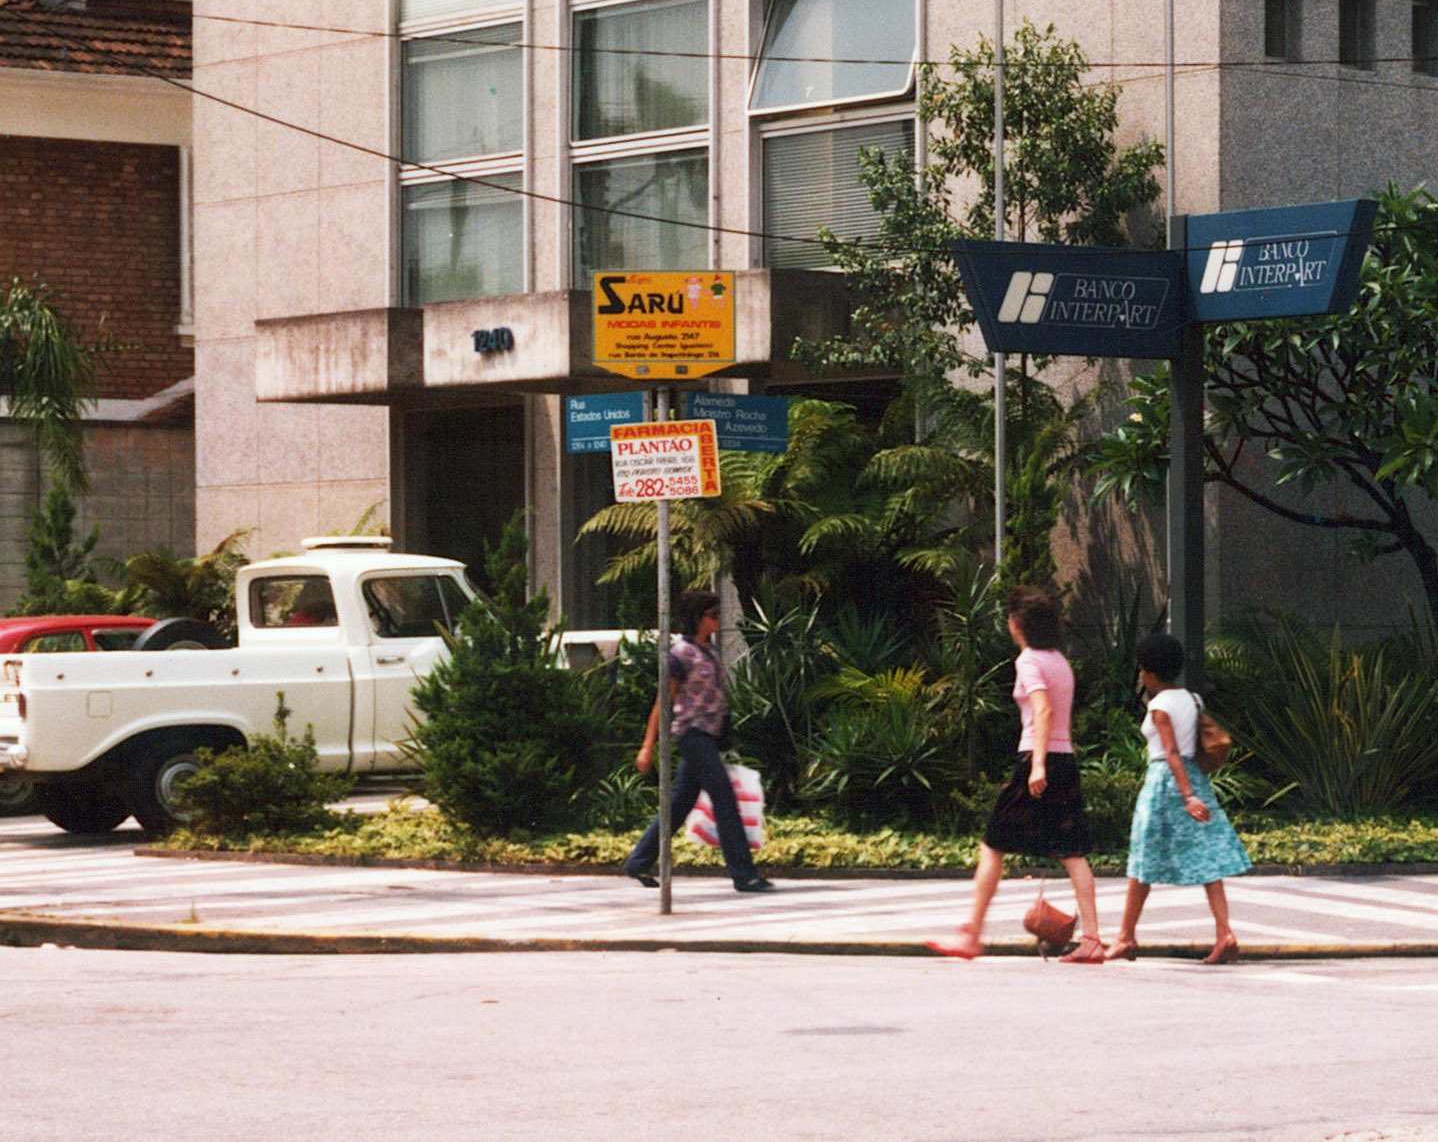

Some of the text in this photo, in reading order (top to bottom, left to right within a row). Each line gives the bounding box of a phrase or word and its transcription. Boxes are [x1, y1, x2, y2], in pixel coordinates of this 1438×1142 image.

[1258, 239, 1309, 261] BANCO
[1240, 259, 1327, 287] INTERPART
[1073, 278, 1136, 300] BANCO
[1050, 301, 1157, 328] INTERPART
[607, 319, 721, 329] MODAS INFANTIS
[471, 327, 515, 353] 1240
[570, 399, 586, 410] Rua
[694, 394, 736, 407] Alameda
[570, 410, 631, 423] Estados Unidos
[693, 407, 767, 420] Ministro Rocha
[725, 421, 767, 433] Azevedo
